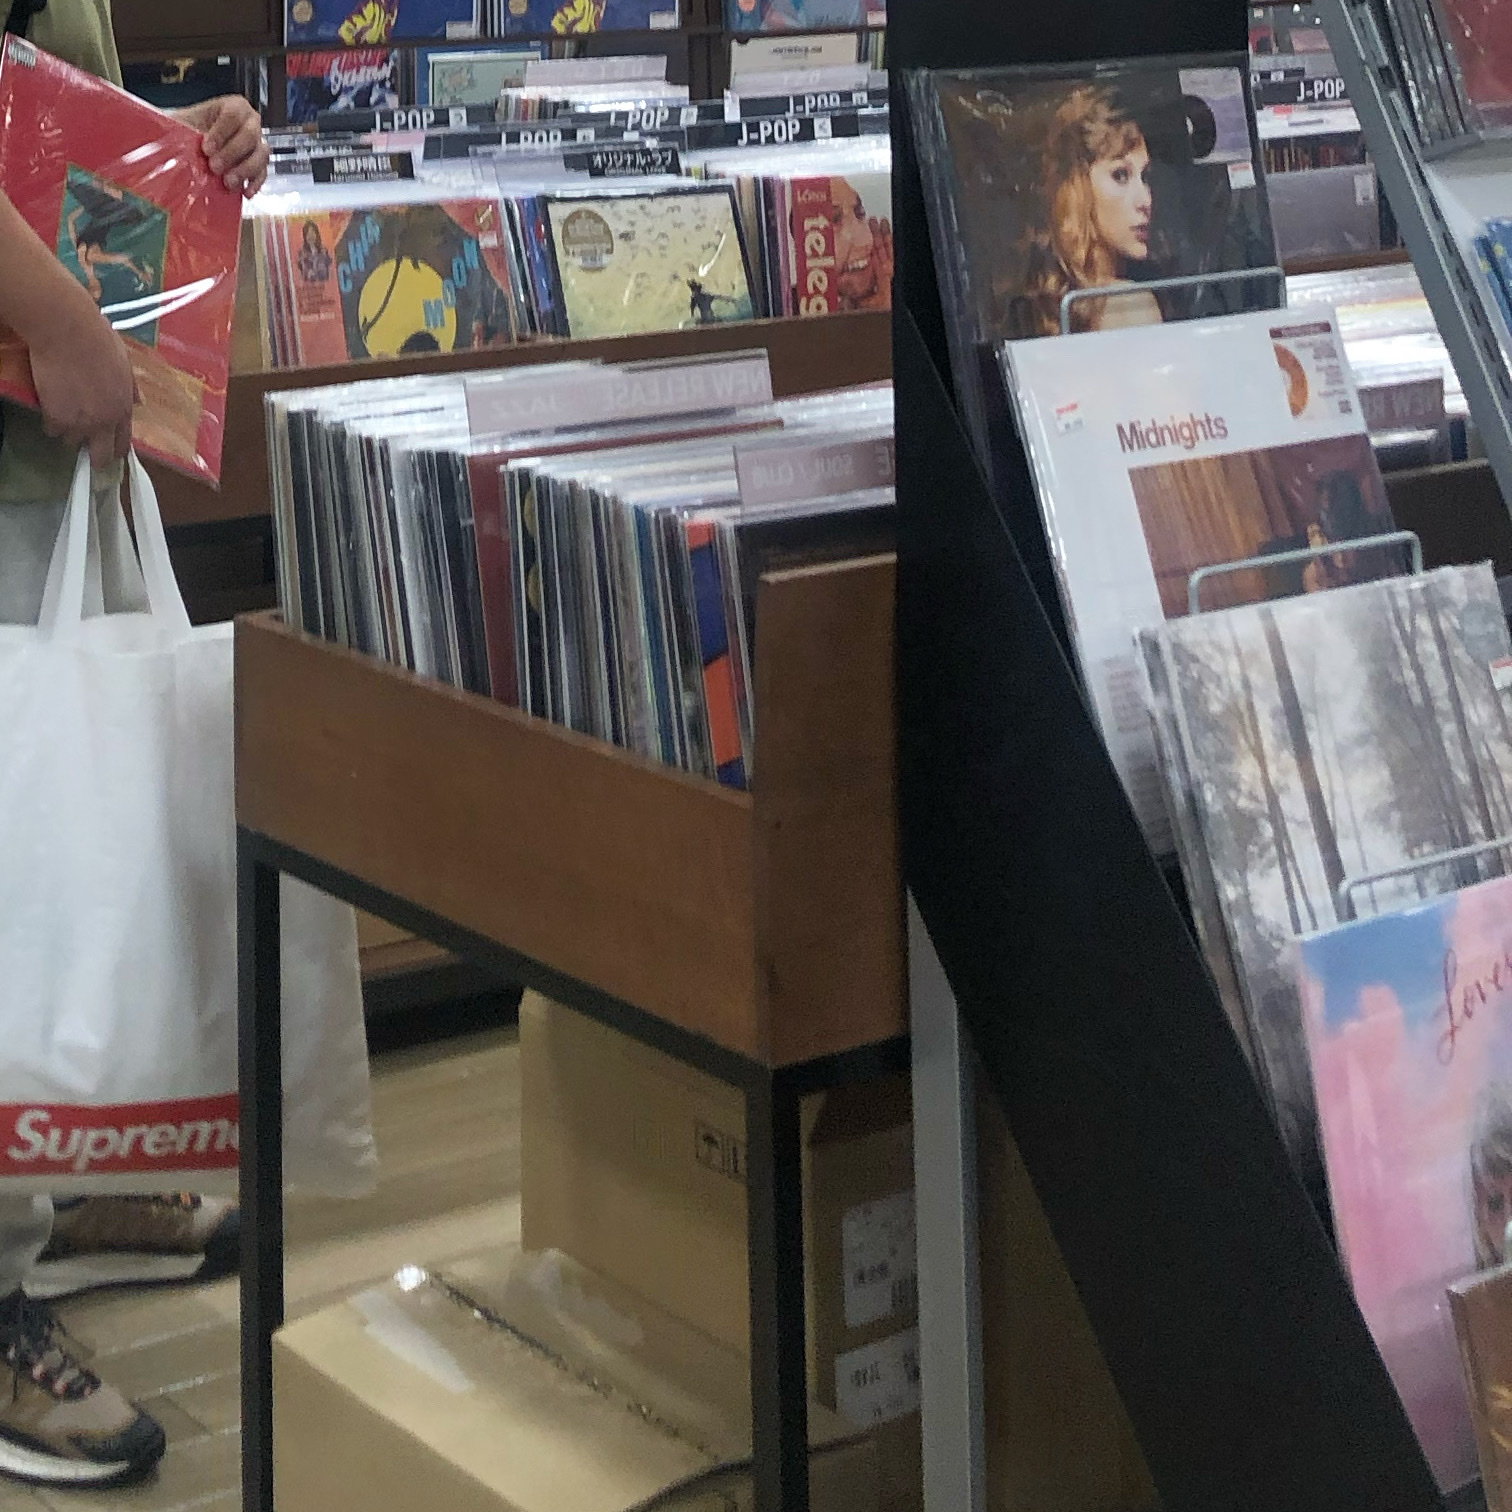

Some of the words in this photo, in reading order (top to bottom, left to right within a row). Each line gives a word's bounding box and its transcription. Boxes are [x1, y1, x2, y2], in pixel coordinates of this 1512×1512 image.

[1297, 78, 1345, 102] J-POP
[501, 130, 563, 150] JPOP
[738, 119, 801, 146] J-POP
[422, 238, 480, 328] MOON
[1116, 411, 1229, 455] Midnights
